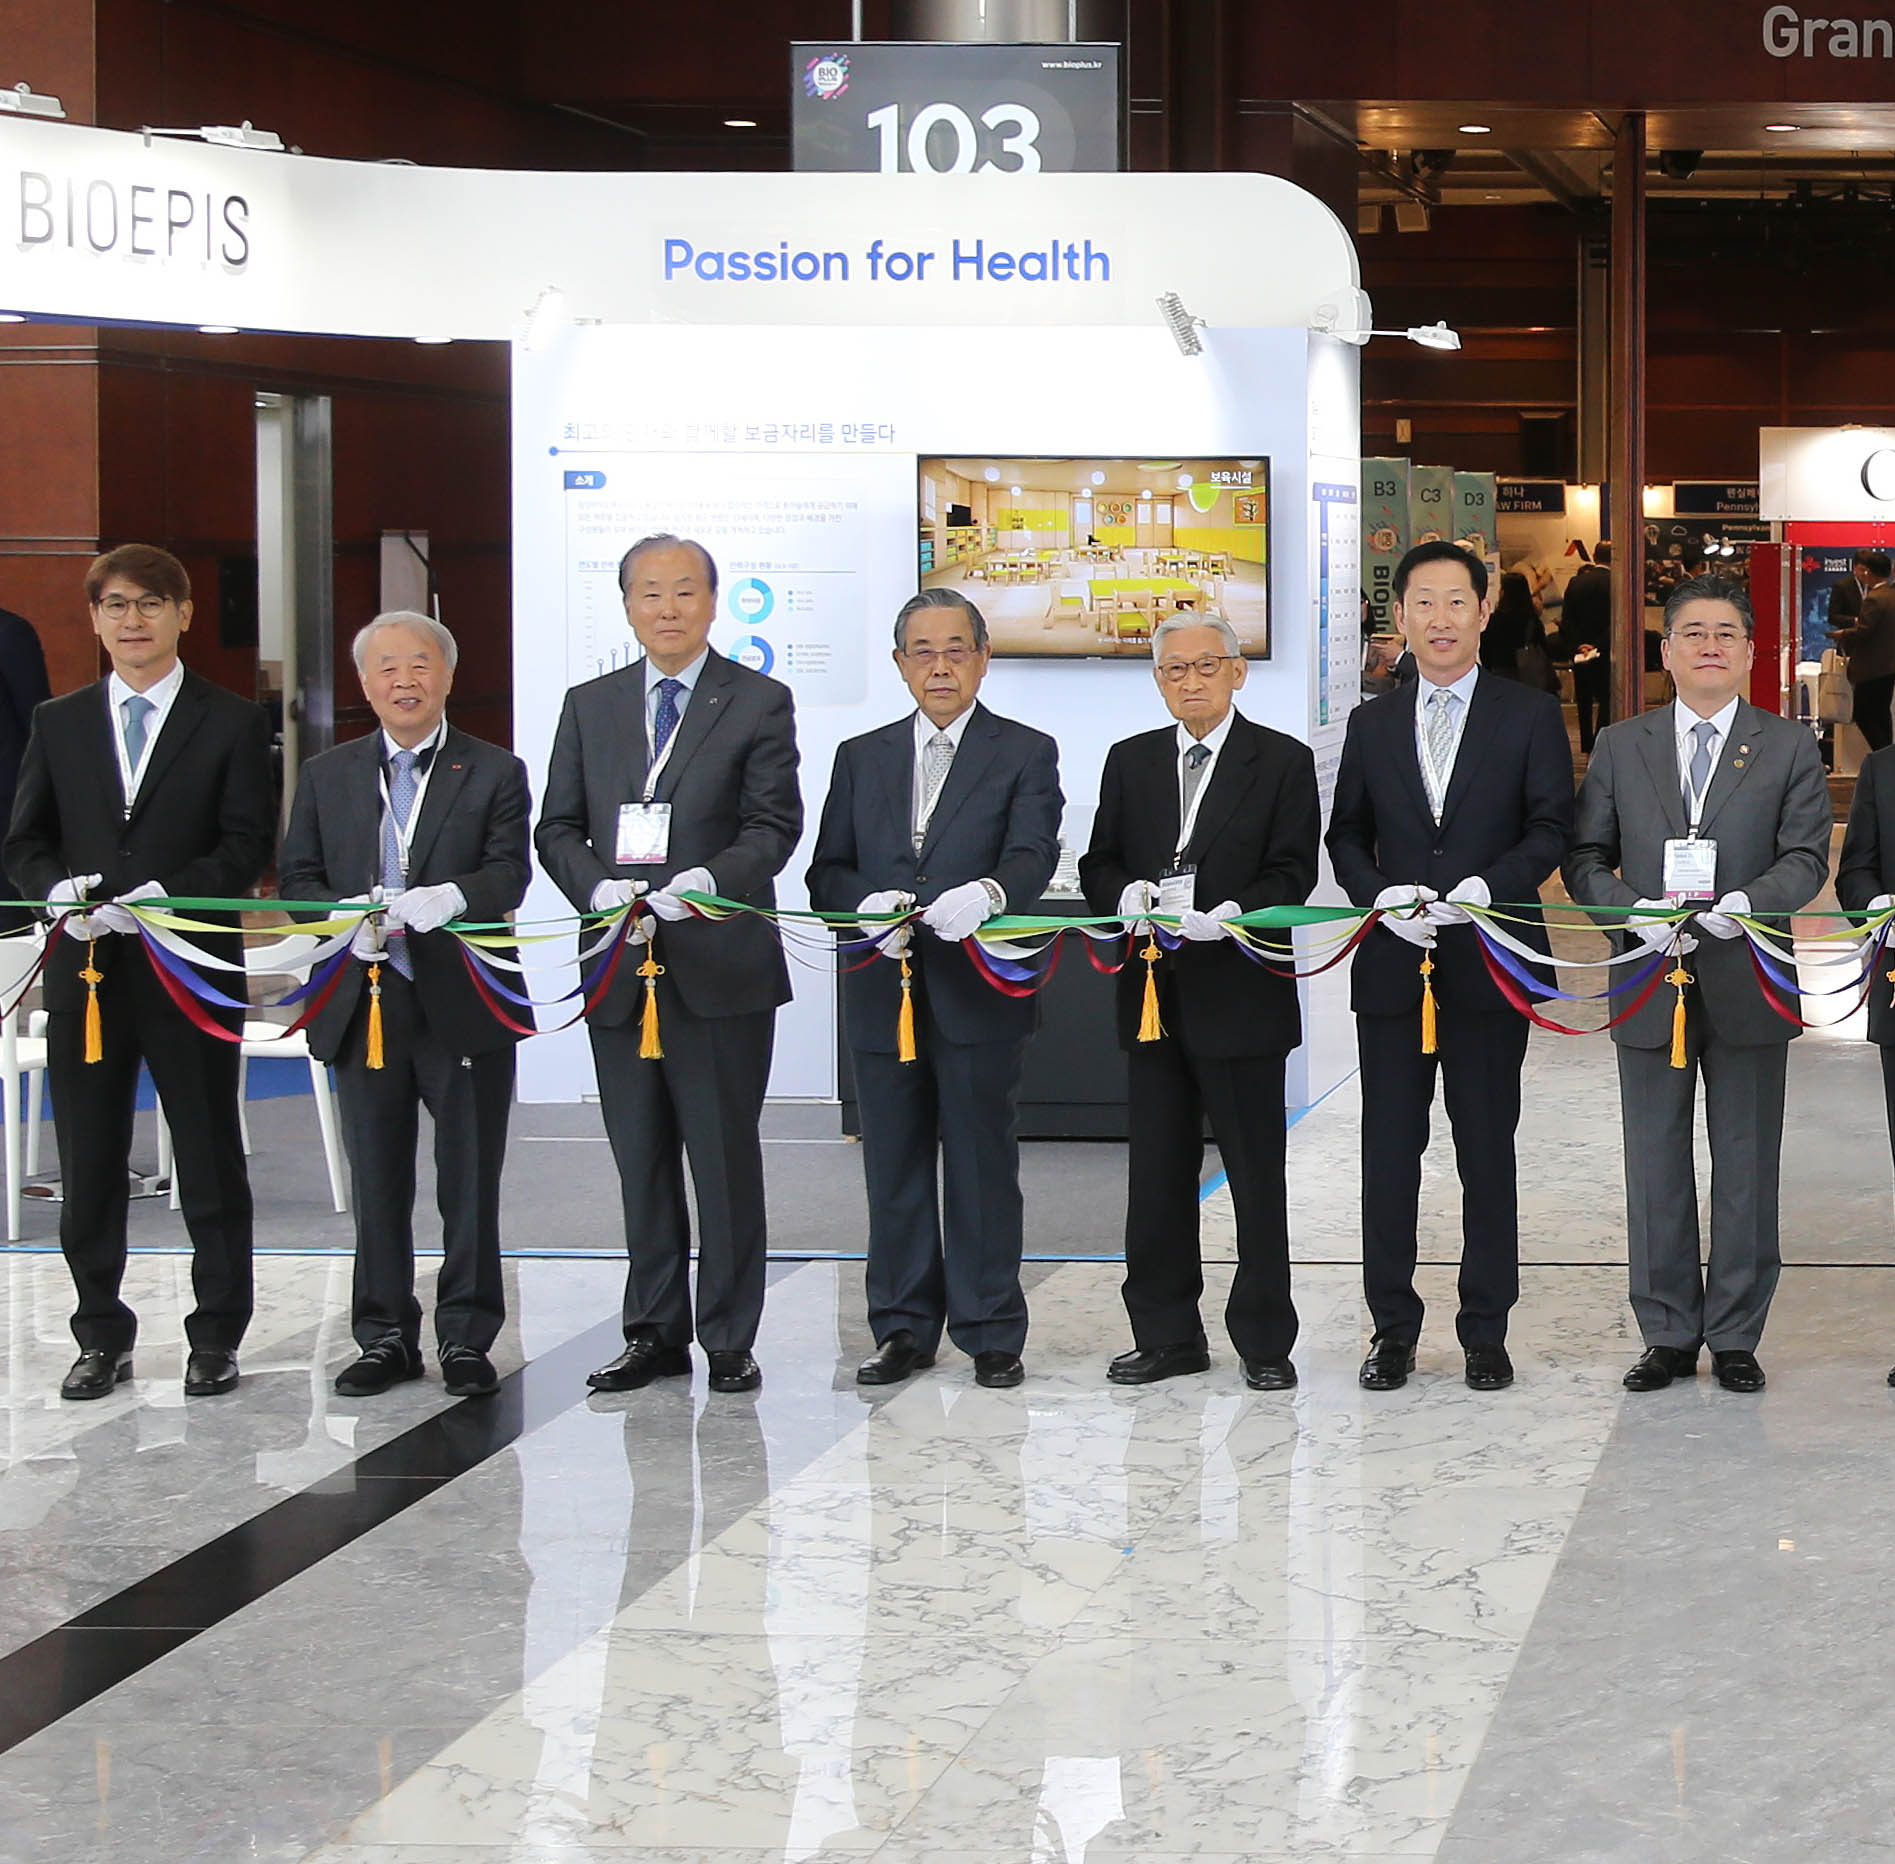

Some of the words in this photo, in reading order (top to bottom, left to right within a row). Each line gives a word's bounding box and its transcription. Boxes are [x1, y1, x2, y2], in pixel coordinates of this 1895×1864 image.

[867, 102, 1041, 174] 103
[20, 172, 250, 267] BIOEPIS
[664, 238, 850, 282] Passion
[867, 238, 934, 282] for
[953, 238, 1110, 282] Health
[745, 423, 836, 444] 보금자리를
[841, 423, 897, 444] 만들다
[1210, 471, 1252, 484] 보육시설
[1374, 481, 1396, 496] B3
[1420, 488, 1441, 503] C3
[1465, 492, 1484, 506] D3
[1496, 501, 1512, 511] AW
[1514, 500, 1543, 511] FIRM
[1716, 501, 1760, 513] Pennsyl
